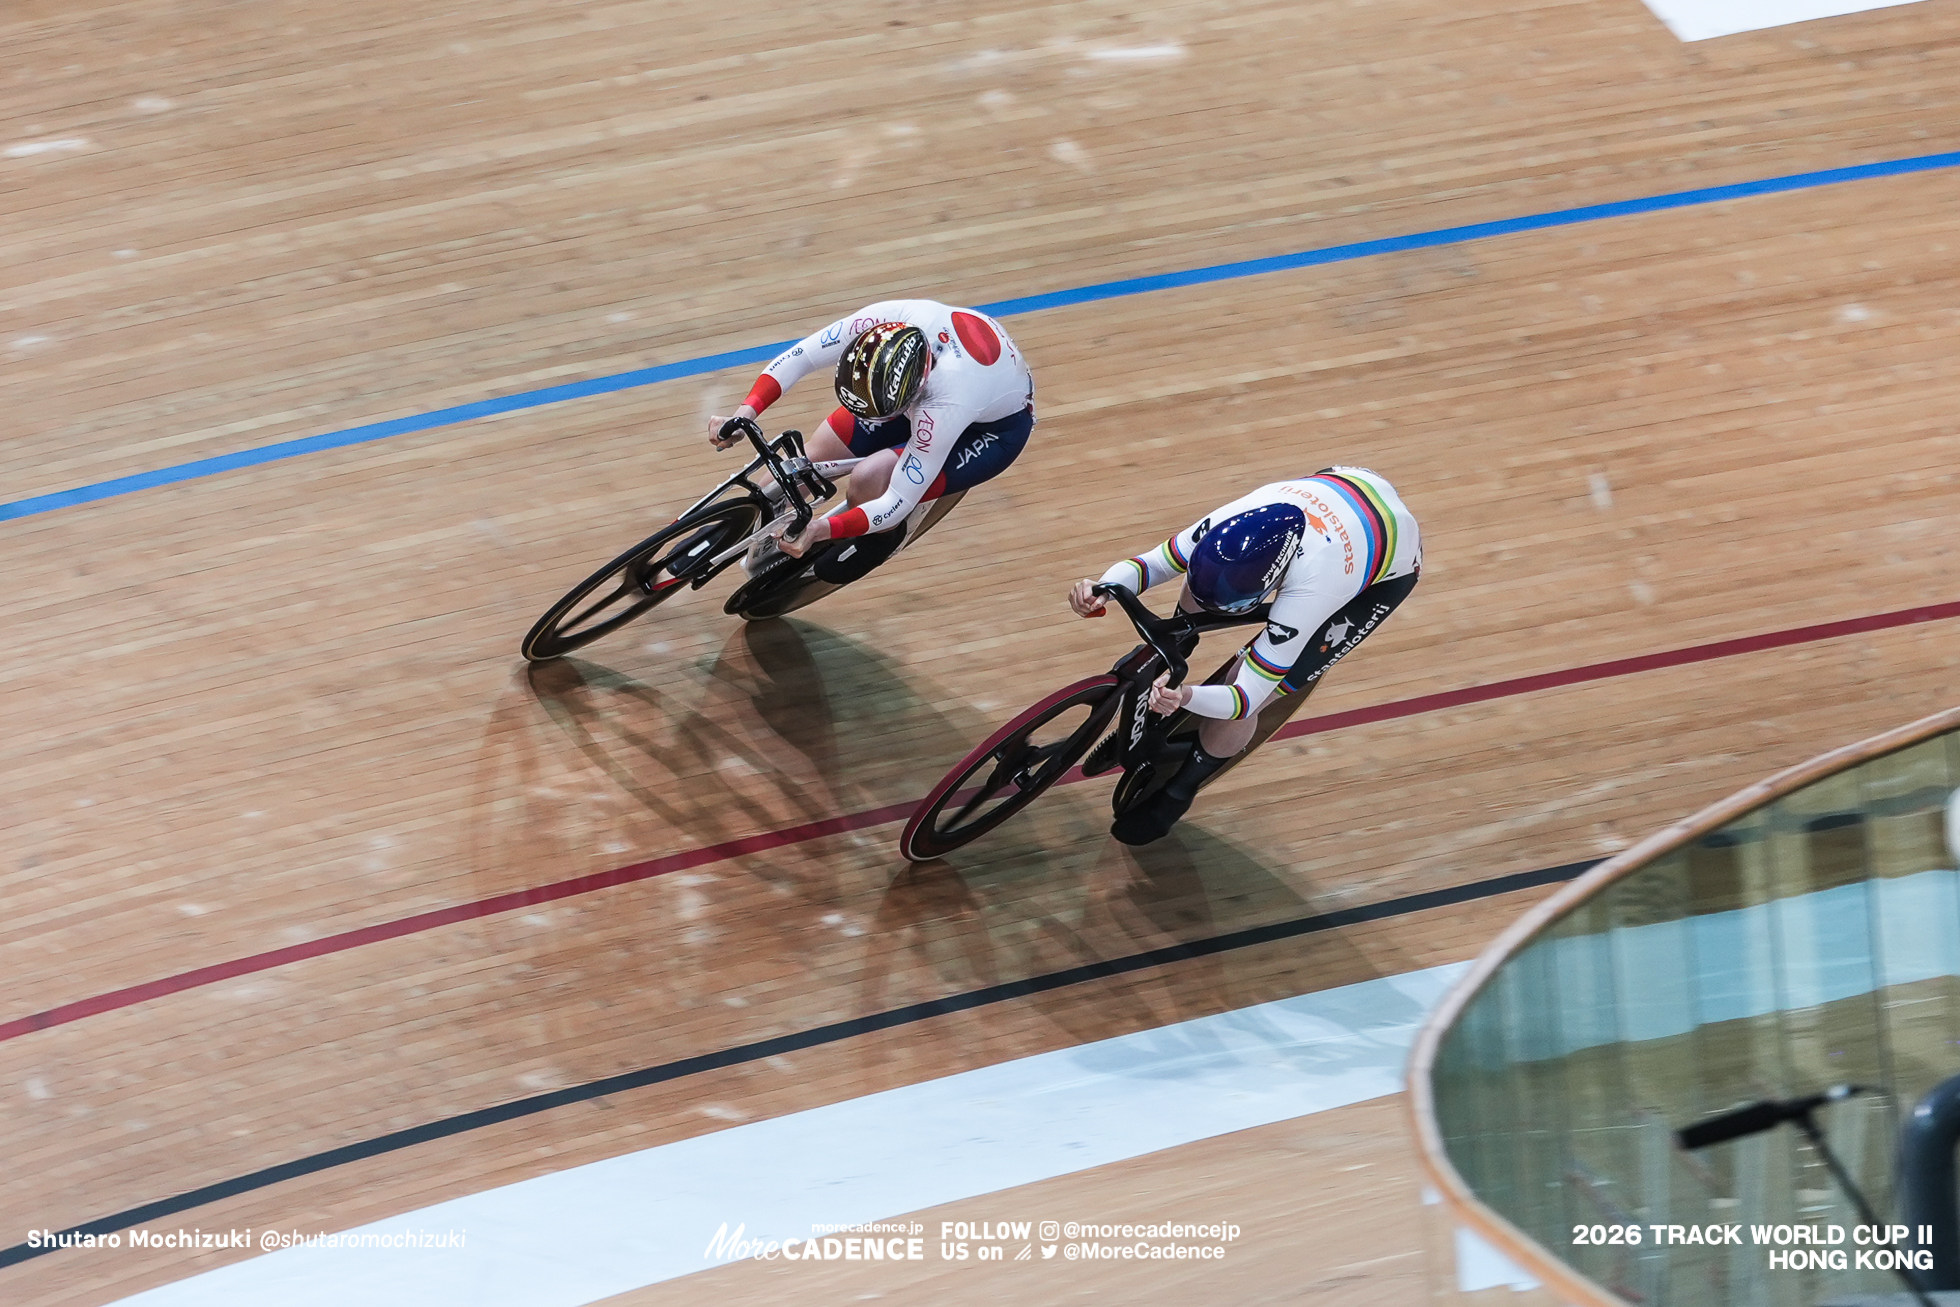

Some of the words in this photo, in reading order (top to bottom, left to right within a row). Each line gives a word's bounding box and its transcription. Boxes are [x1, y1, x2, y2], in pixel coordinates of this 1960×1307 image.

[886, 336, 917, 402] Kabuto
[883, 498, 904, 519] Cyclers
[1278, 485, 1354, 576] Staatsloterij
[1128, 687, 1151, 752] KOGA
